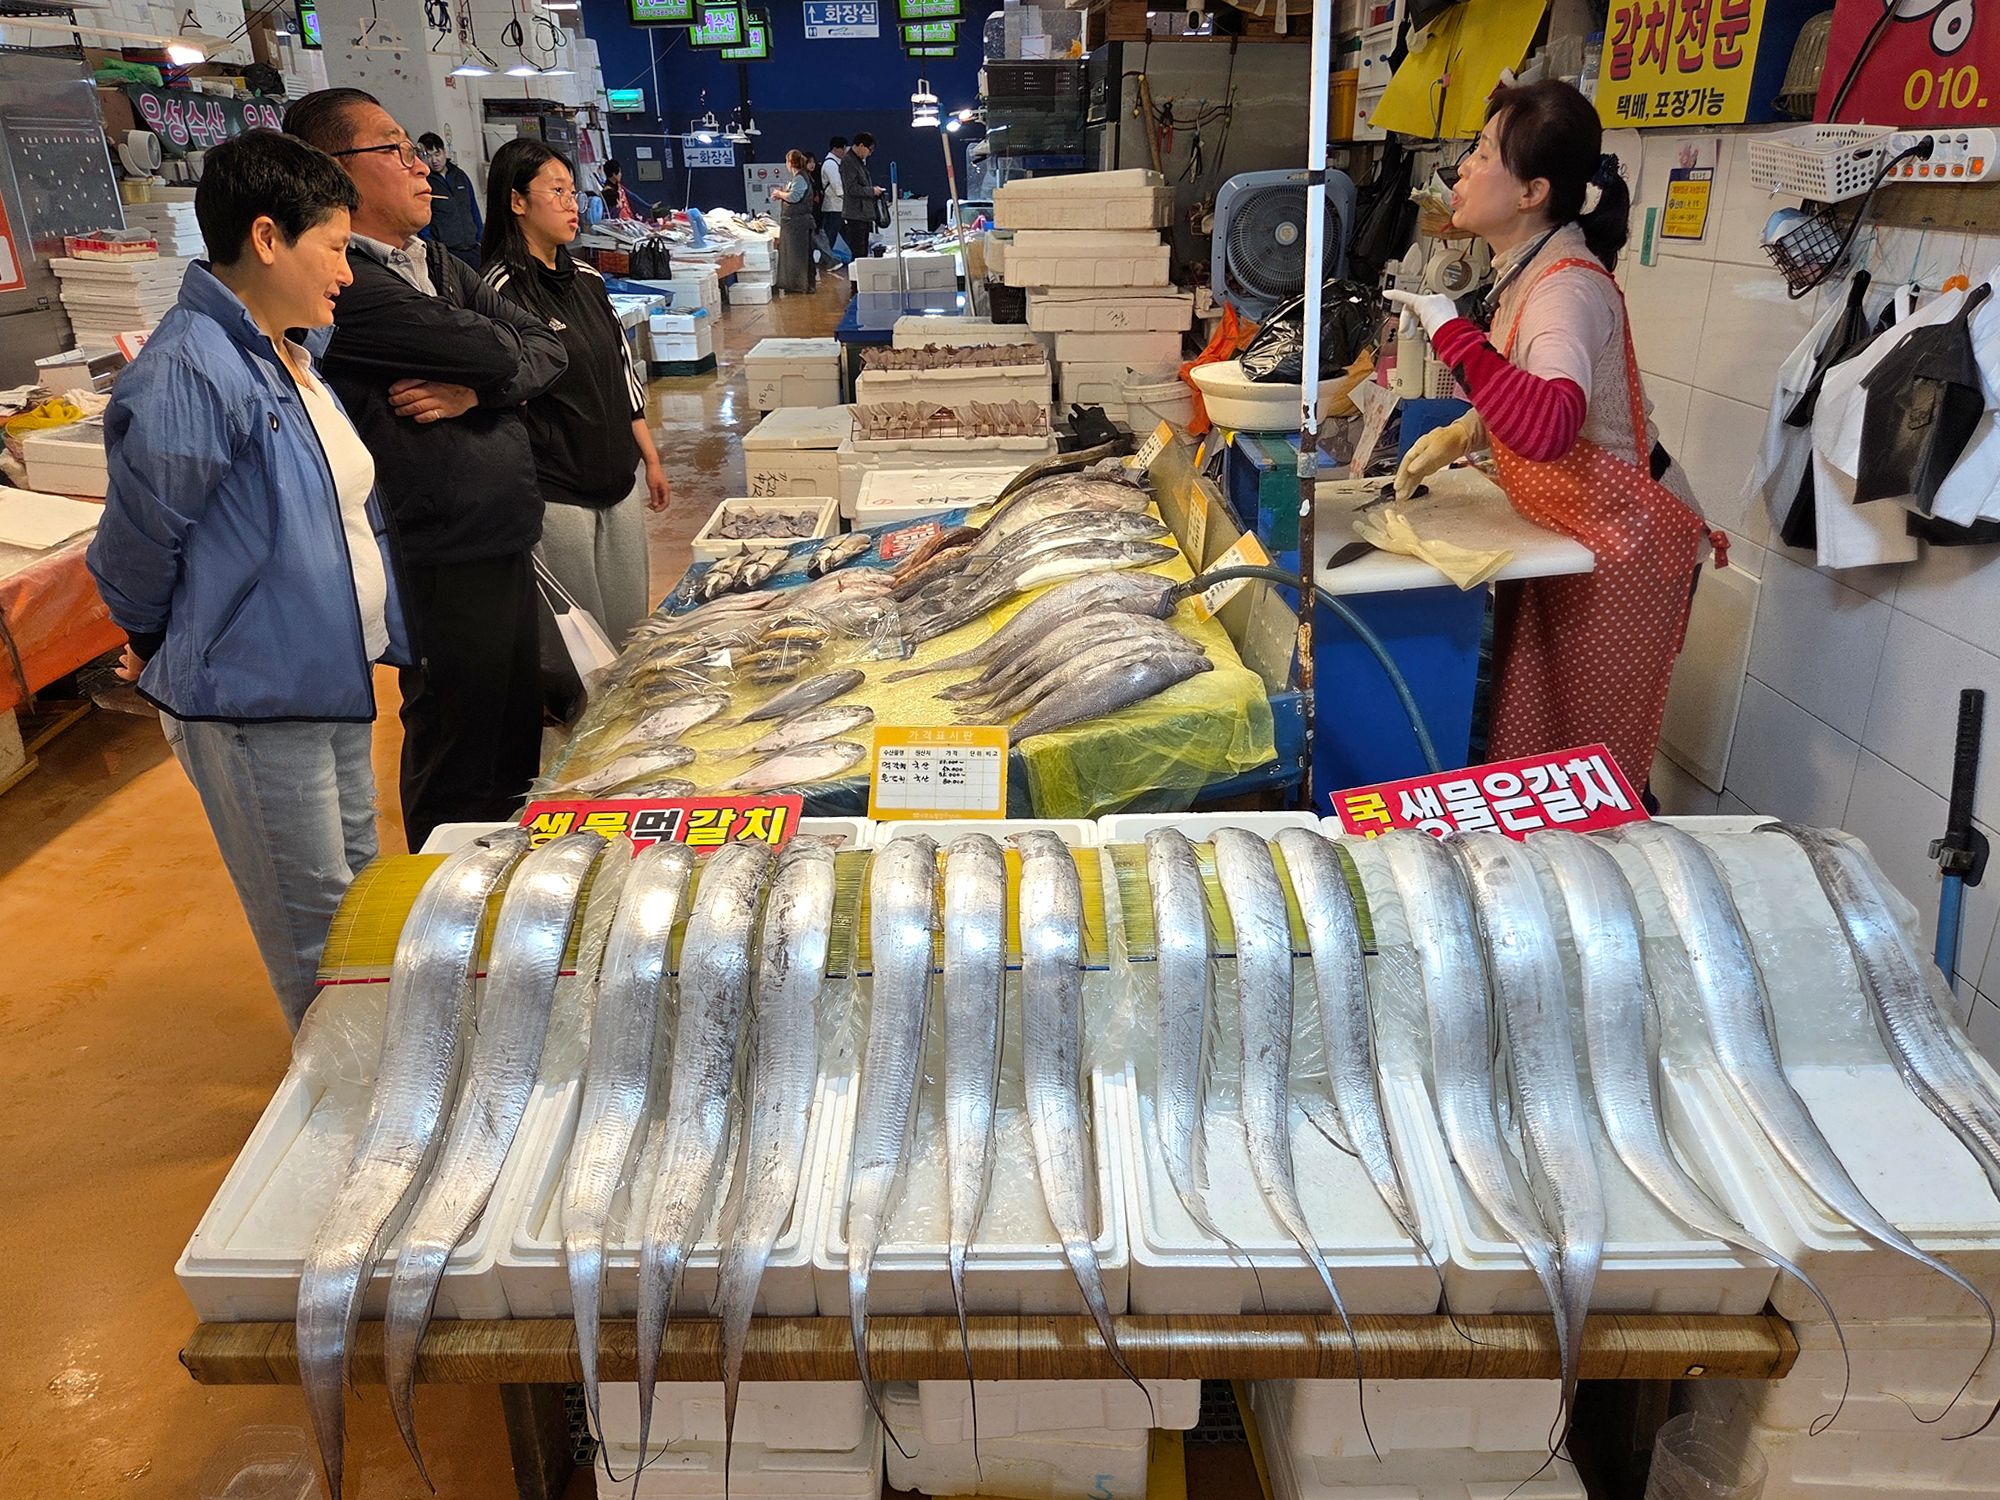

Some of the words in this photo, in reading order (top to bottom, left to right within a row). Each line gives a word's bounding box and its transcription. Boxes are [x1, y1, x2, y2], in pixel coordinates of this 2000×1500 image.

[825, 4, 876, 24] 화장실
[1610, 0, 1750, 81] 갈치전문
[1616, 93, 1650, 121] 택배,
[1653, 87, 1725, 118] 포장가능
[139, 93, 228, 147] 유성수산
[699, 149, 734, 166] 화장실
[909, 730, 974, 740] 가격표시판
